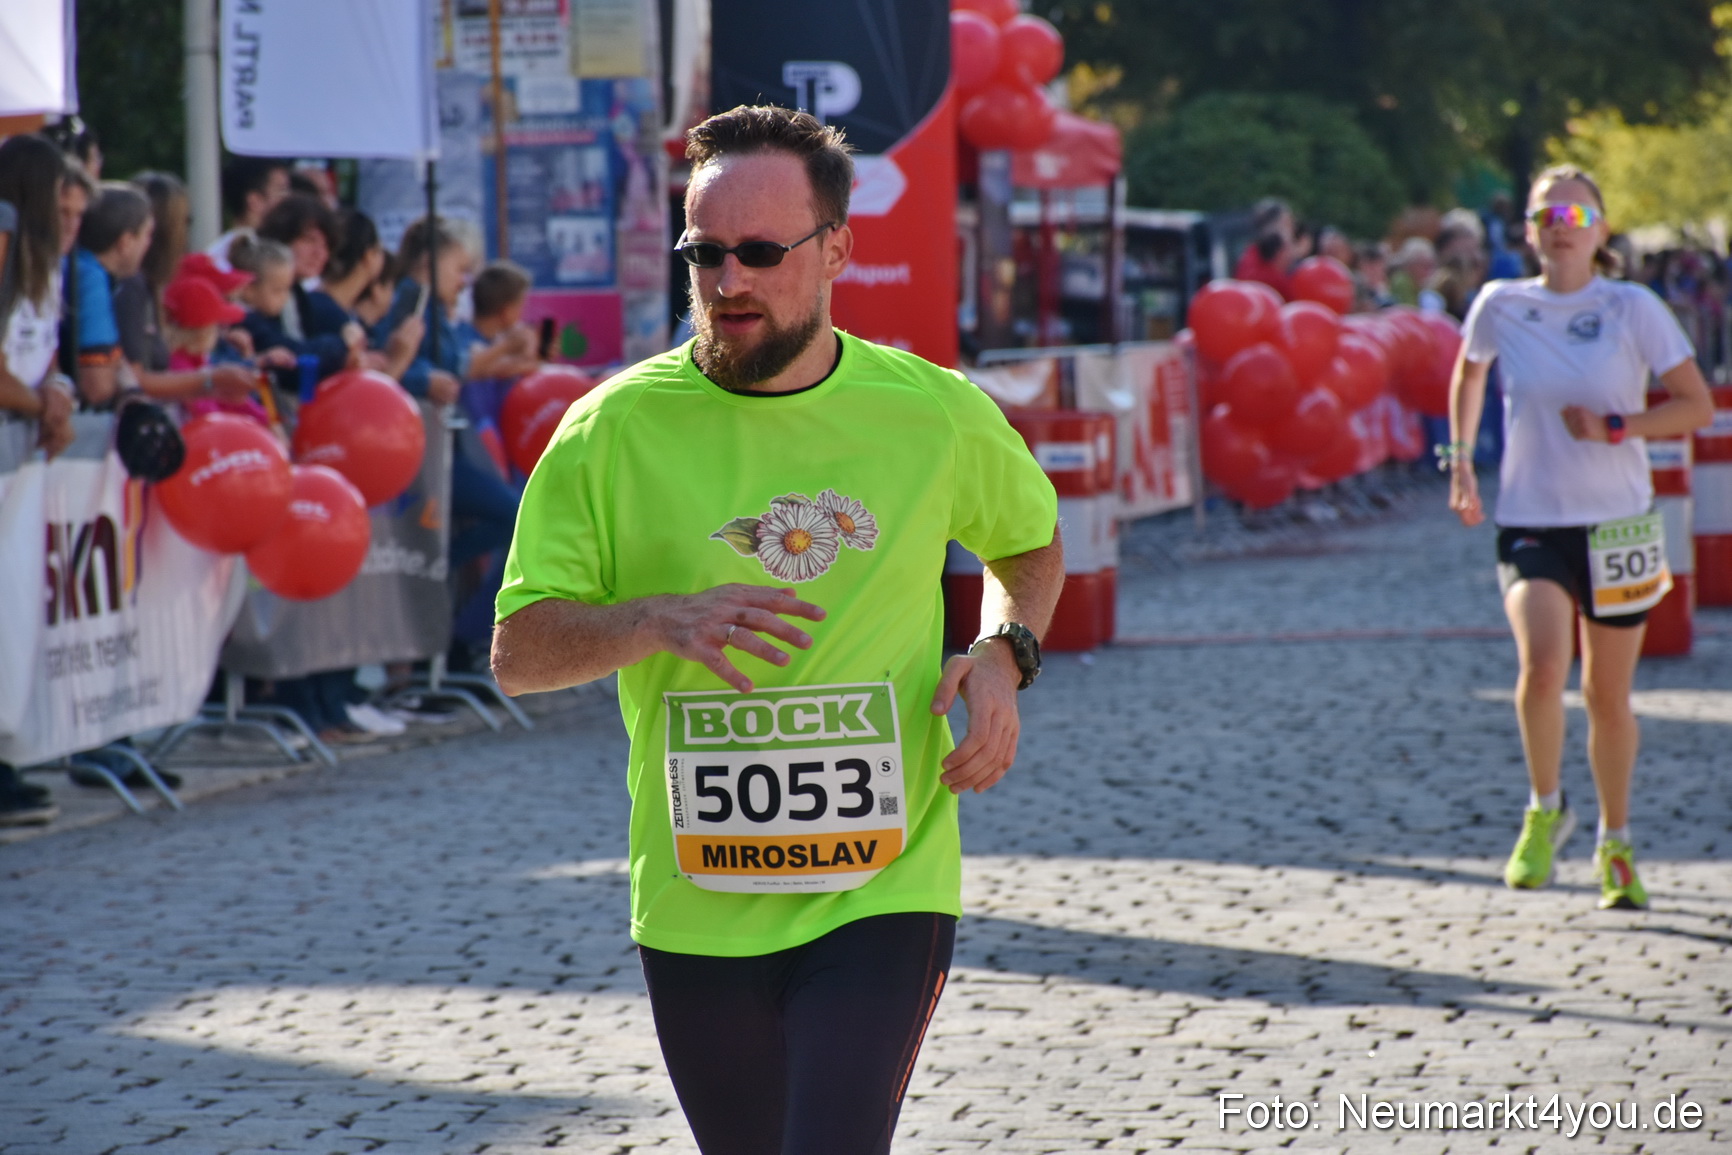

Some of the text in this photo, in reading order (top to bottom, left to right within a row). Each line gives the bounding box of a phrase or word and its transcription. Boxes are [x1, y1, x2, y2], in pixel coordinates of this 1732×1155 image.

[684, 692, 880, 745] BOCK
[881, 760, 891, 772] S
[695, 758, 875, 823] 5053
[701, 839, 879, 869] MIROSLAV
